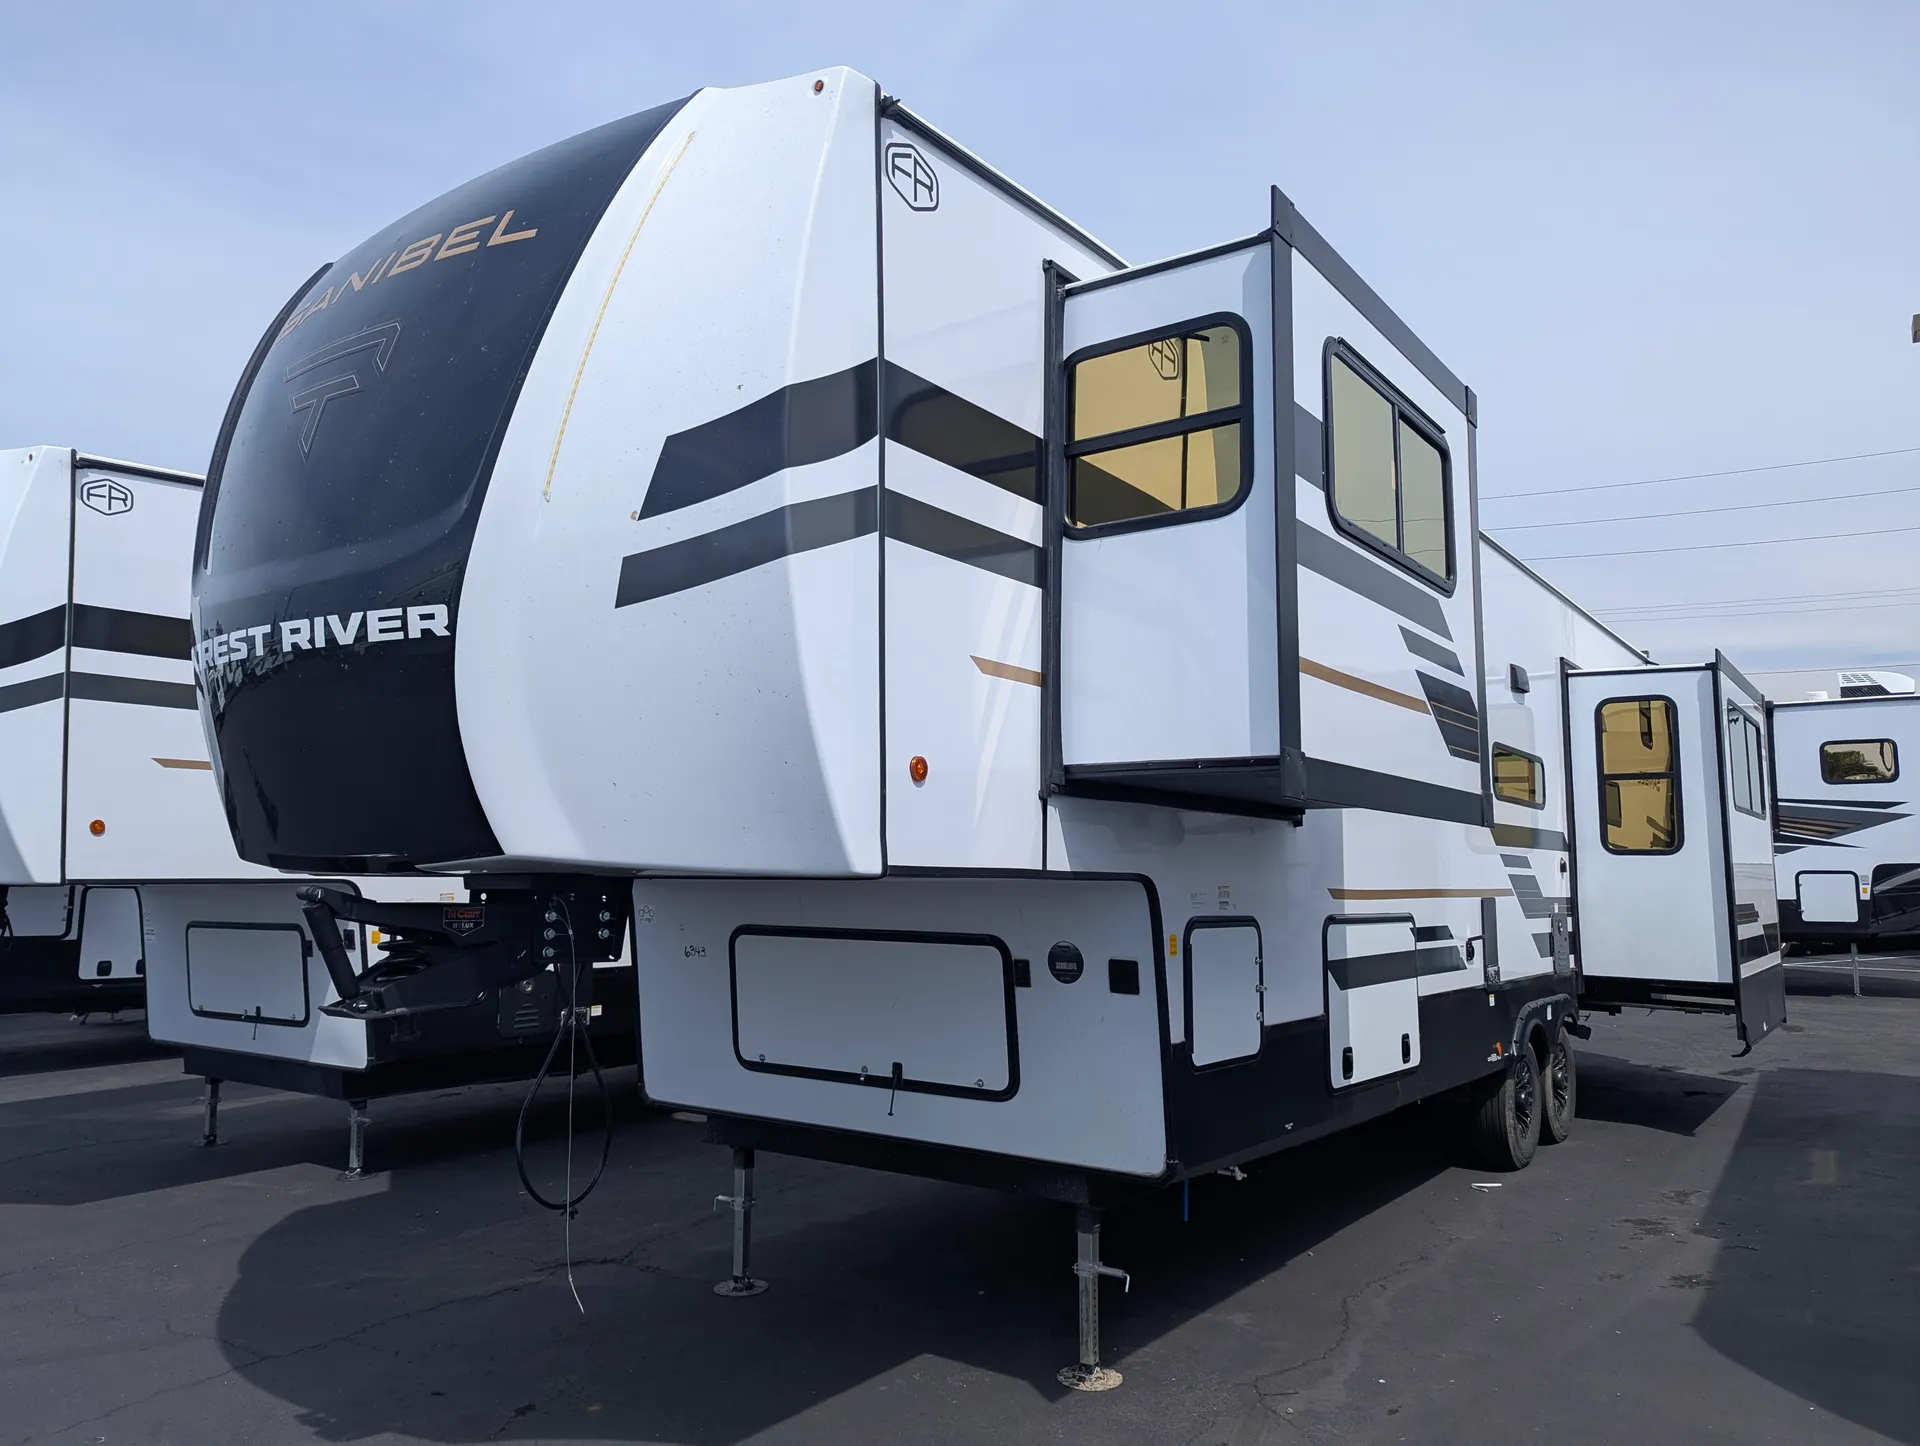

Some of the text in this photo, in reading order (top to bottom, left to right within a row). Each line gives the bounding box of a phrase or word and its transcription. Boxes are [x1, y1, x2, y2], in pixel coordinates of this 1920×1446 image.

[275, 209, 537, 344] SANIBEL
[191, 604, 451, 671] OREST RIVER
[684, 945, 706, 958] 6343
